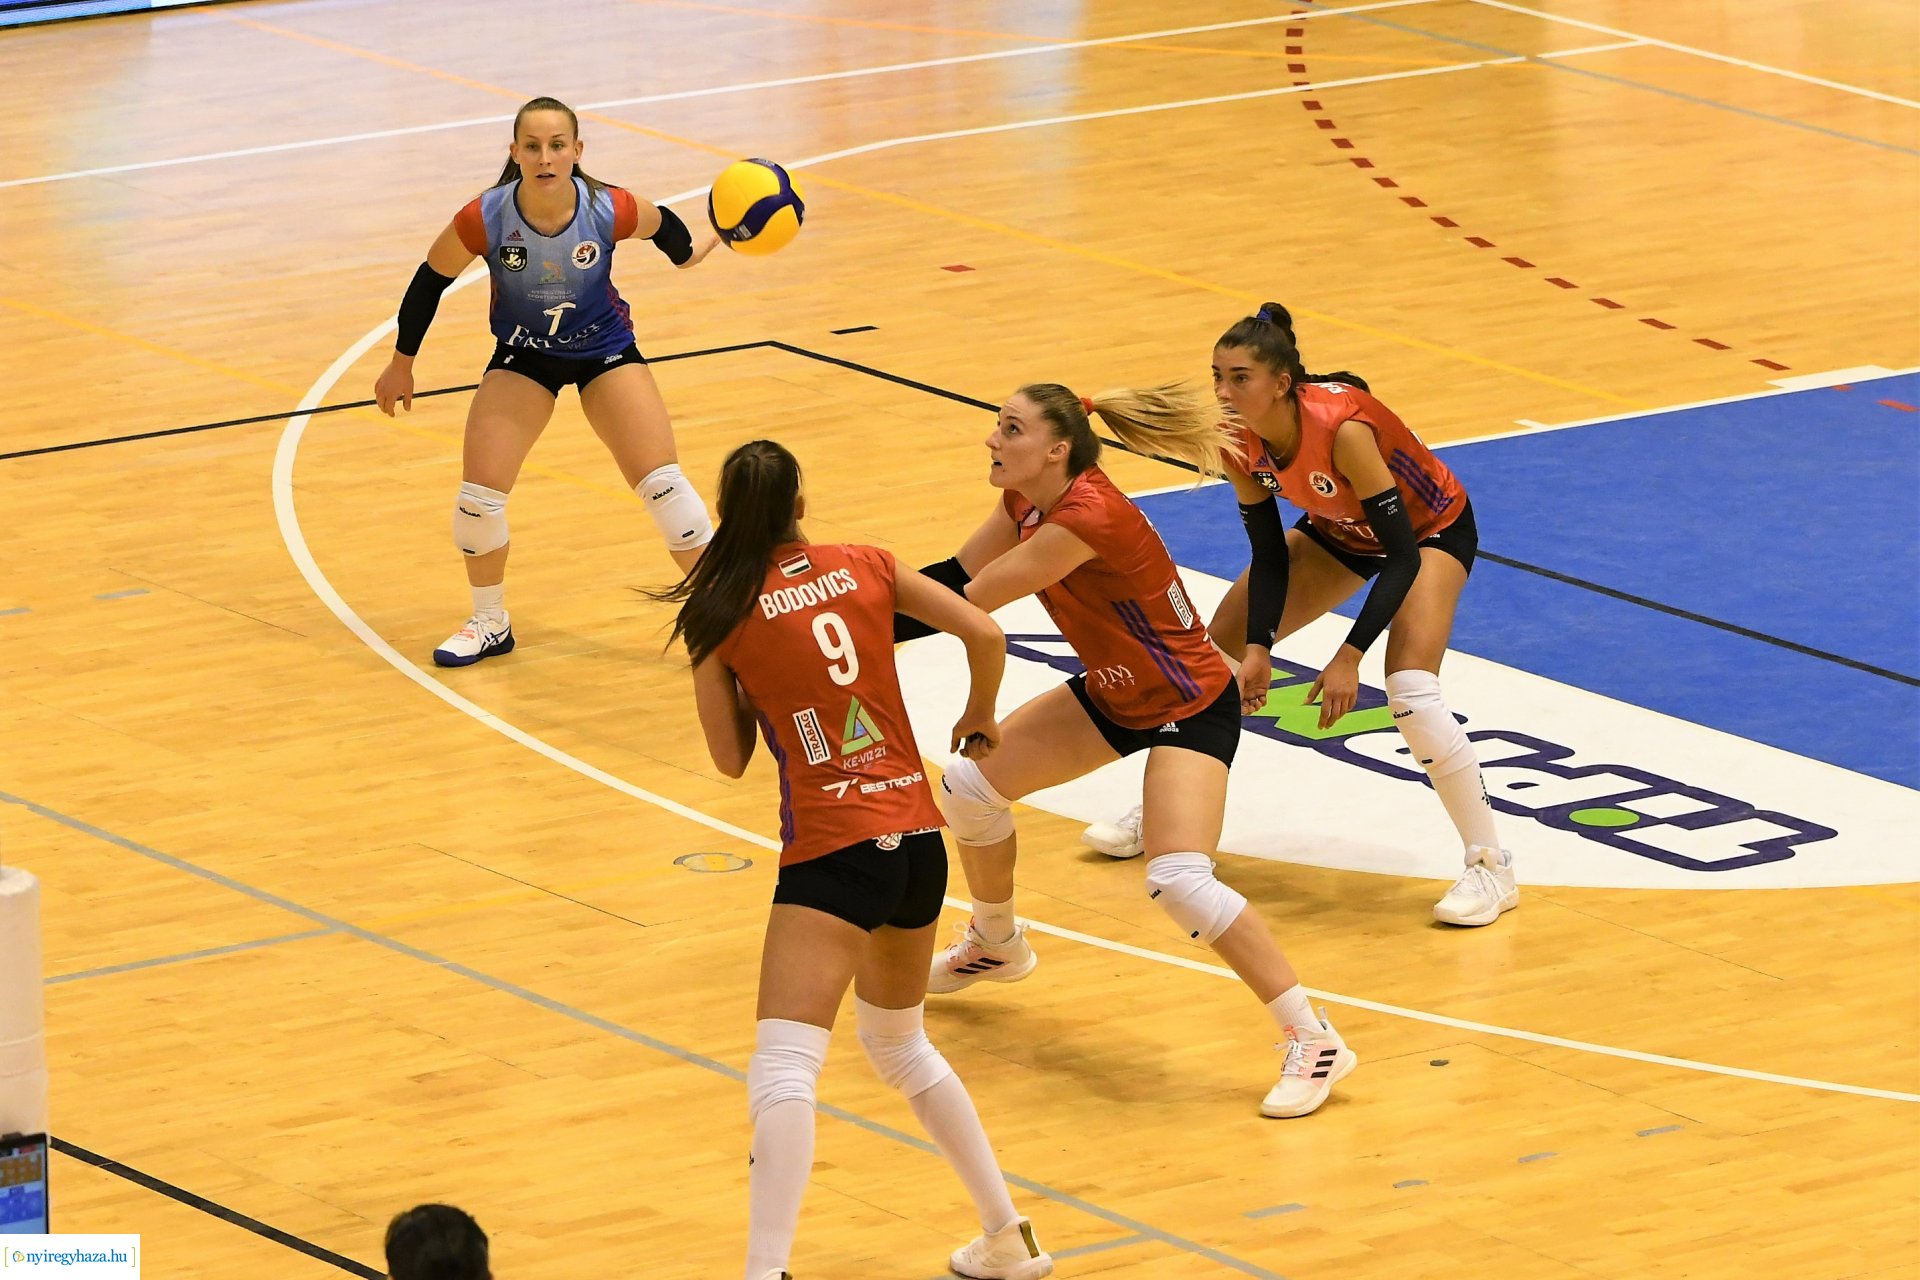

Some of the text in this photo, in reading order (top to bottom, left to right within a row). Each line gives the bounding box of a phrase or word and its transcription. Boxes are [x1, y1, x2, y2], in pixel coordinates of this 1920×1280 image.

[543, 301, 577, 336] 1
[652, 486, 675, 500] MIKASA
[758, 568, 858, 620] BODOVICS
[811, 611, 860, 687] 9
[800, 713, 824, 761] STRABAG
[859, 772, 923, 794] BESTRONG
